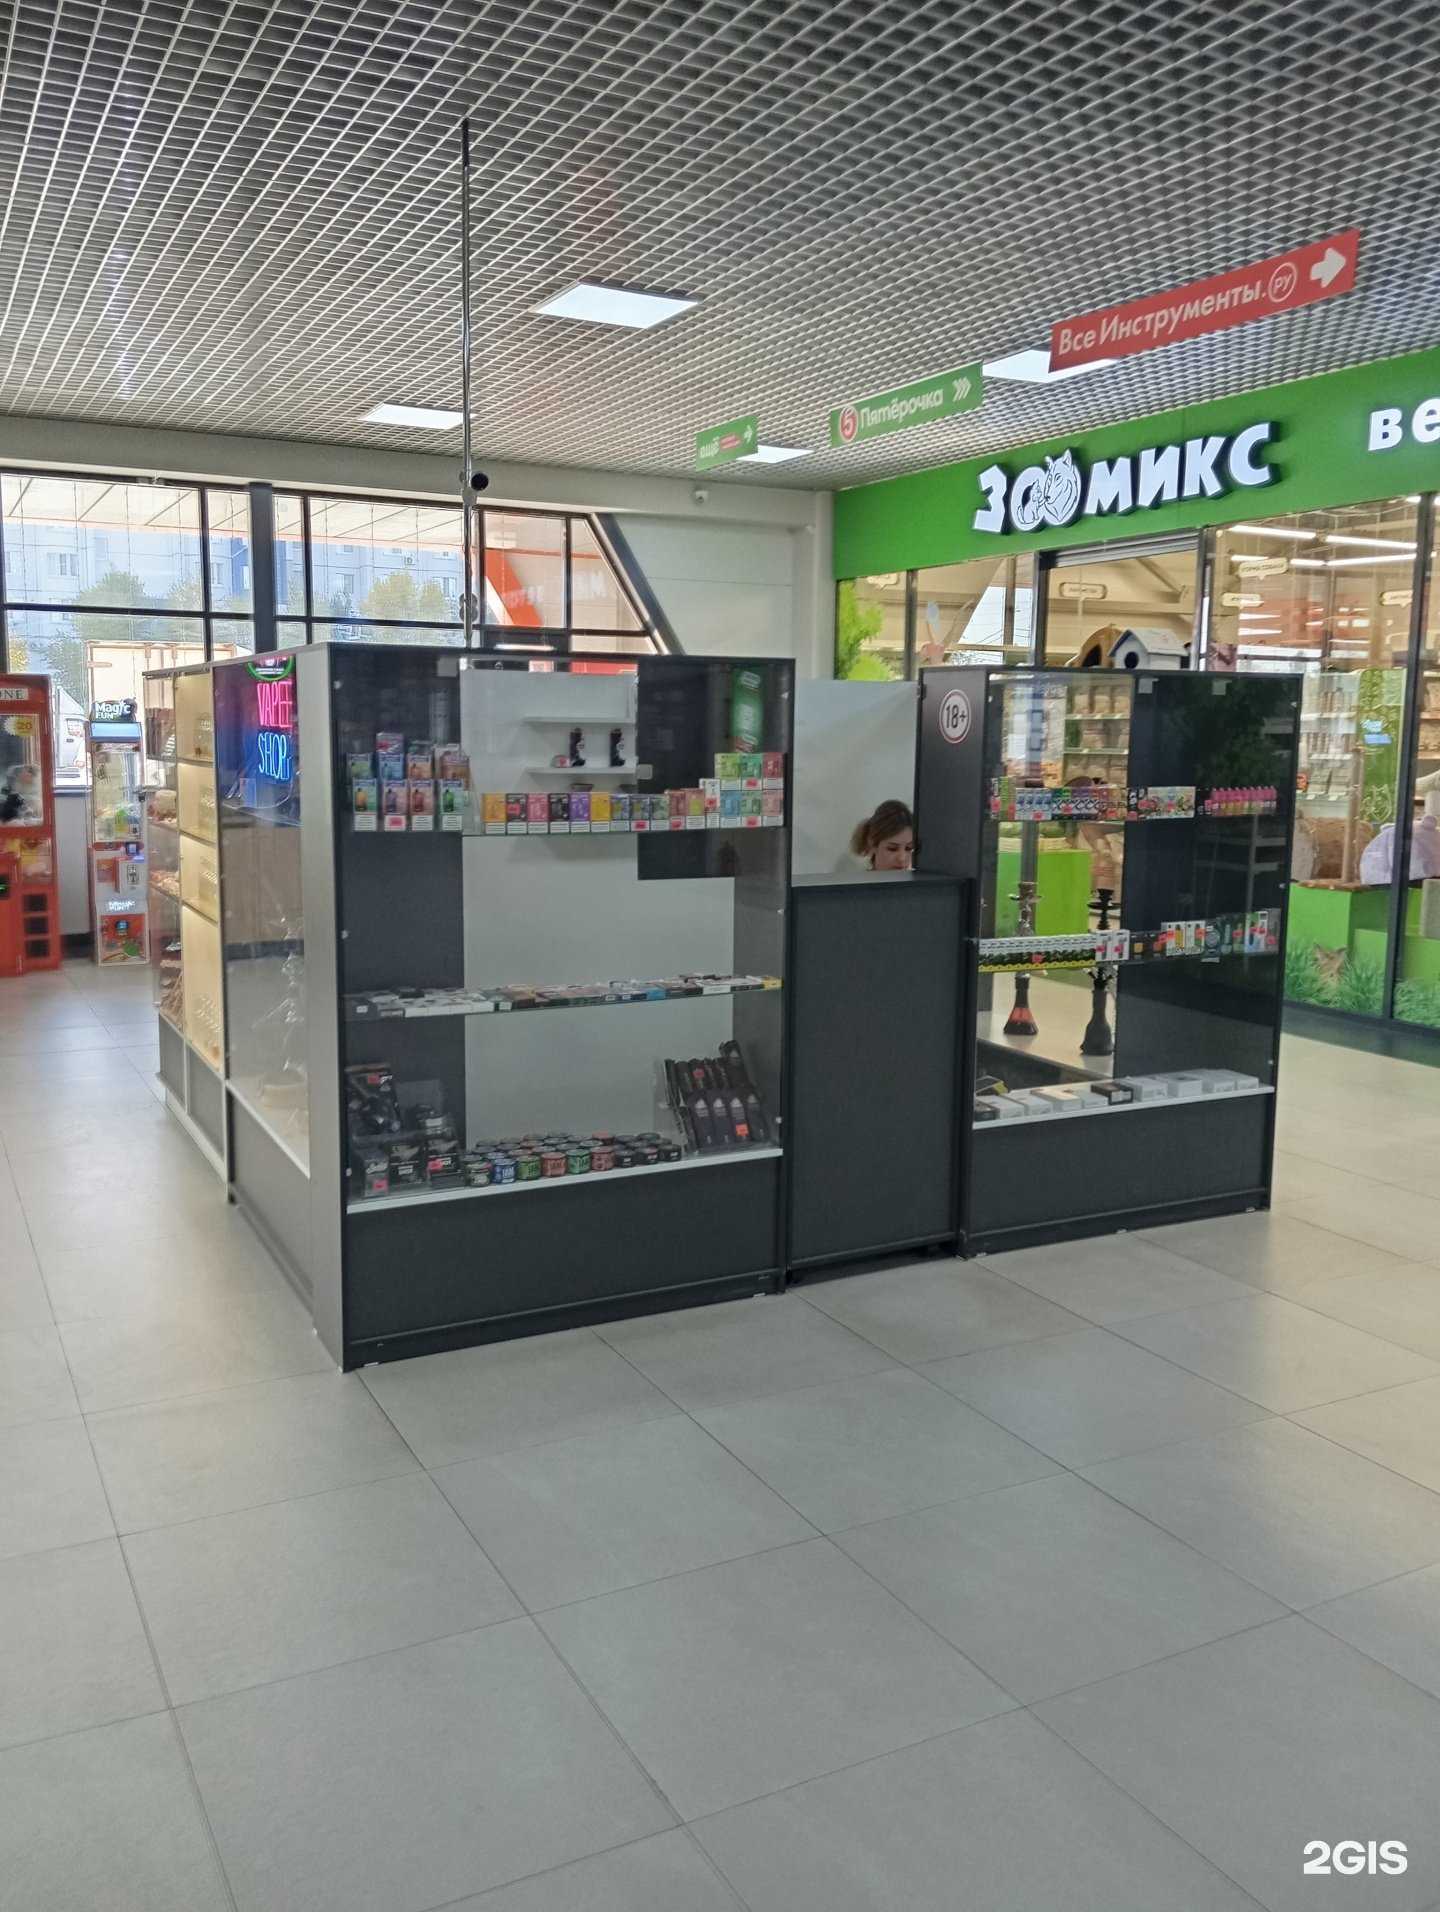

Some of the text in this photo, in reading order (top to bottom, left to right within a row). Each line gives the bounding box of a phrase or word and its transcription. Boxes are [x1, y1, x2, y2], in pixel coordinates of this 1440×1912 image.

[860, 389, 944, 428] Пятёрочка
[0, 689, 25, 700] NE
[946, 704, 966, 729] 18+
[258, 732, 291, 780] SHOP
